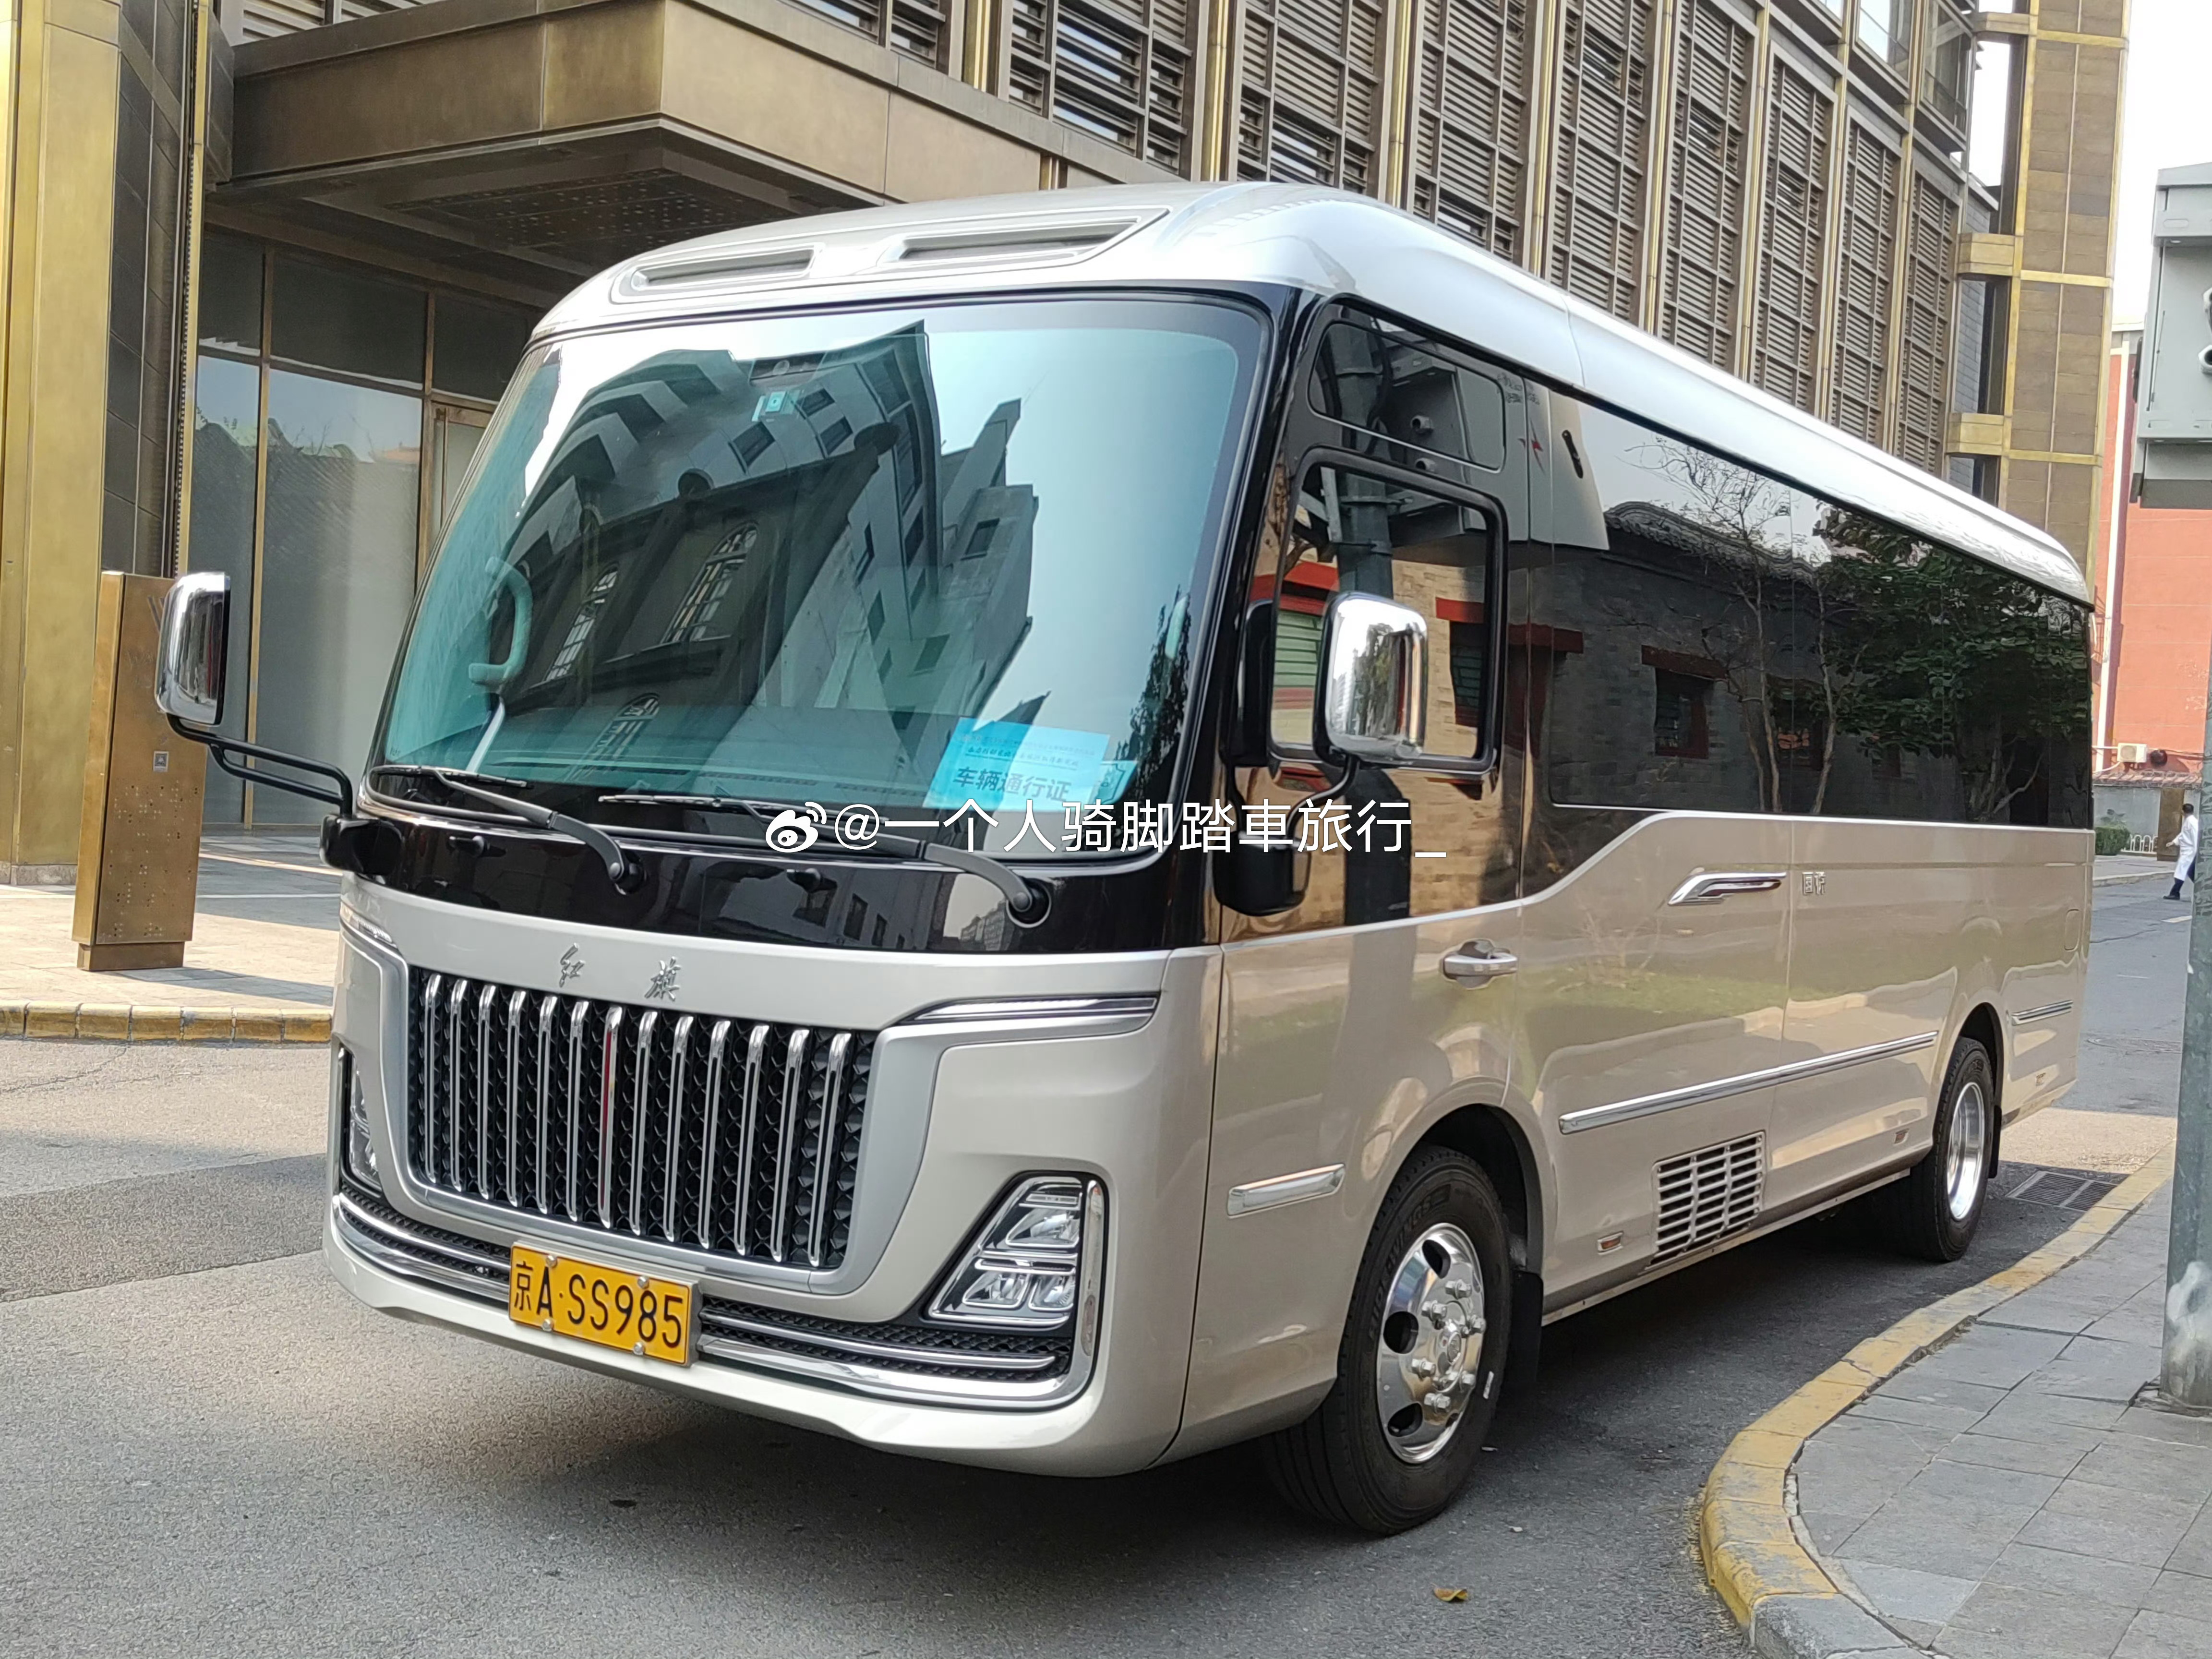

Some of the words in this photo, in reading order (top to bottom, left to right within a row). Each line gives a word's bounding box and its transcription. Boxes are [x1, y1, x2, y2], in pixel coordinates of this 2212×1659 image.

[953, 766, 1072, 802] 车辆通行证
